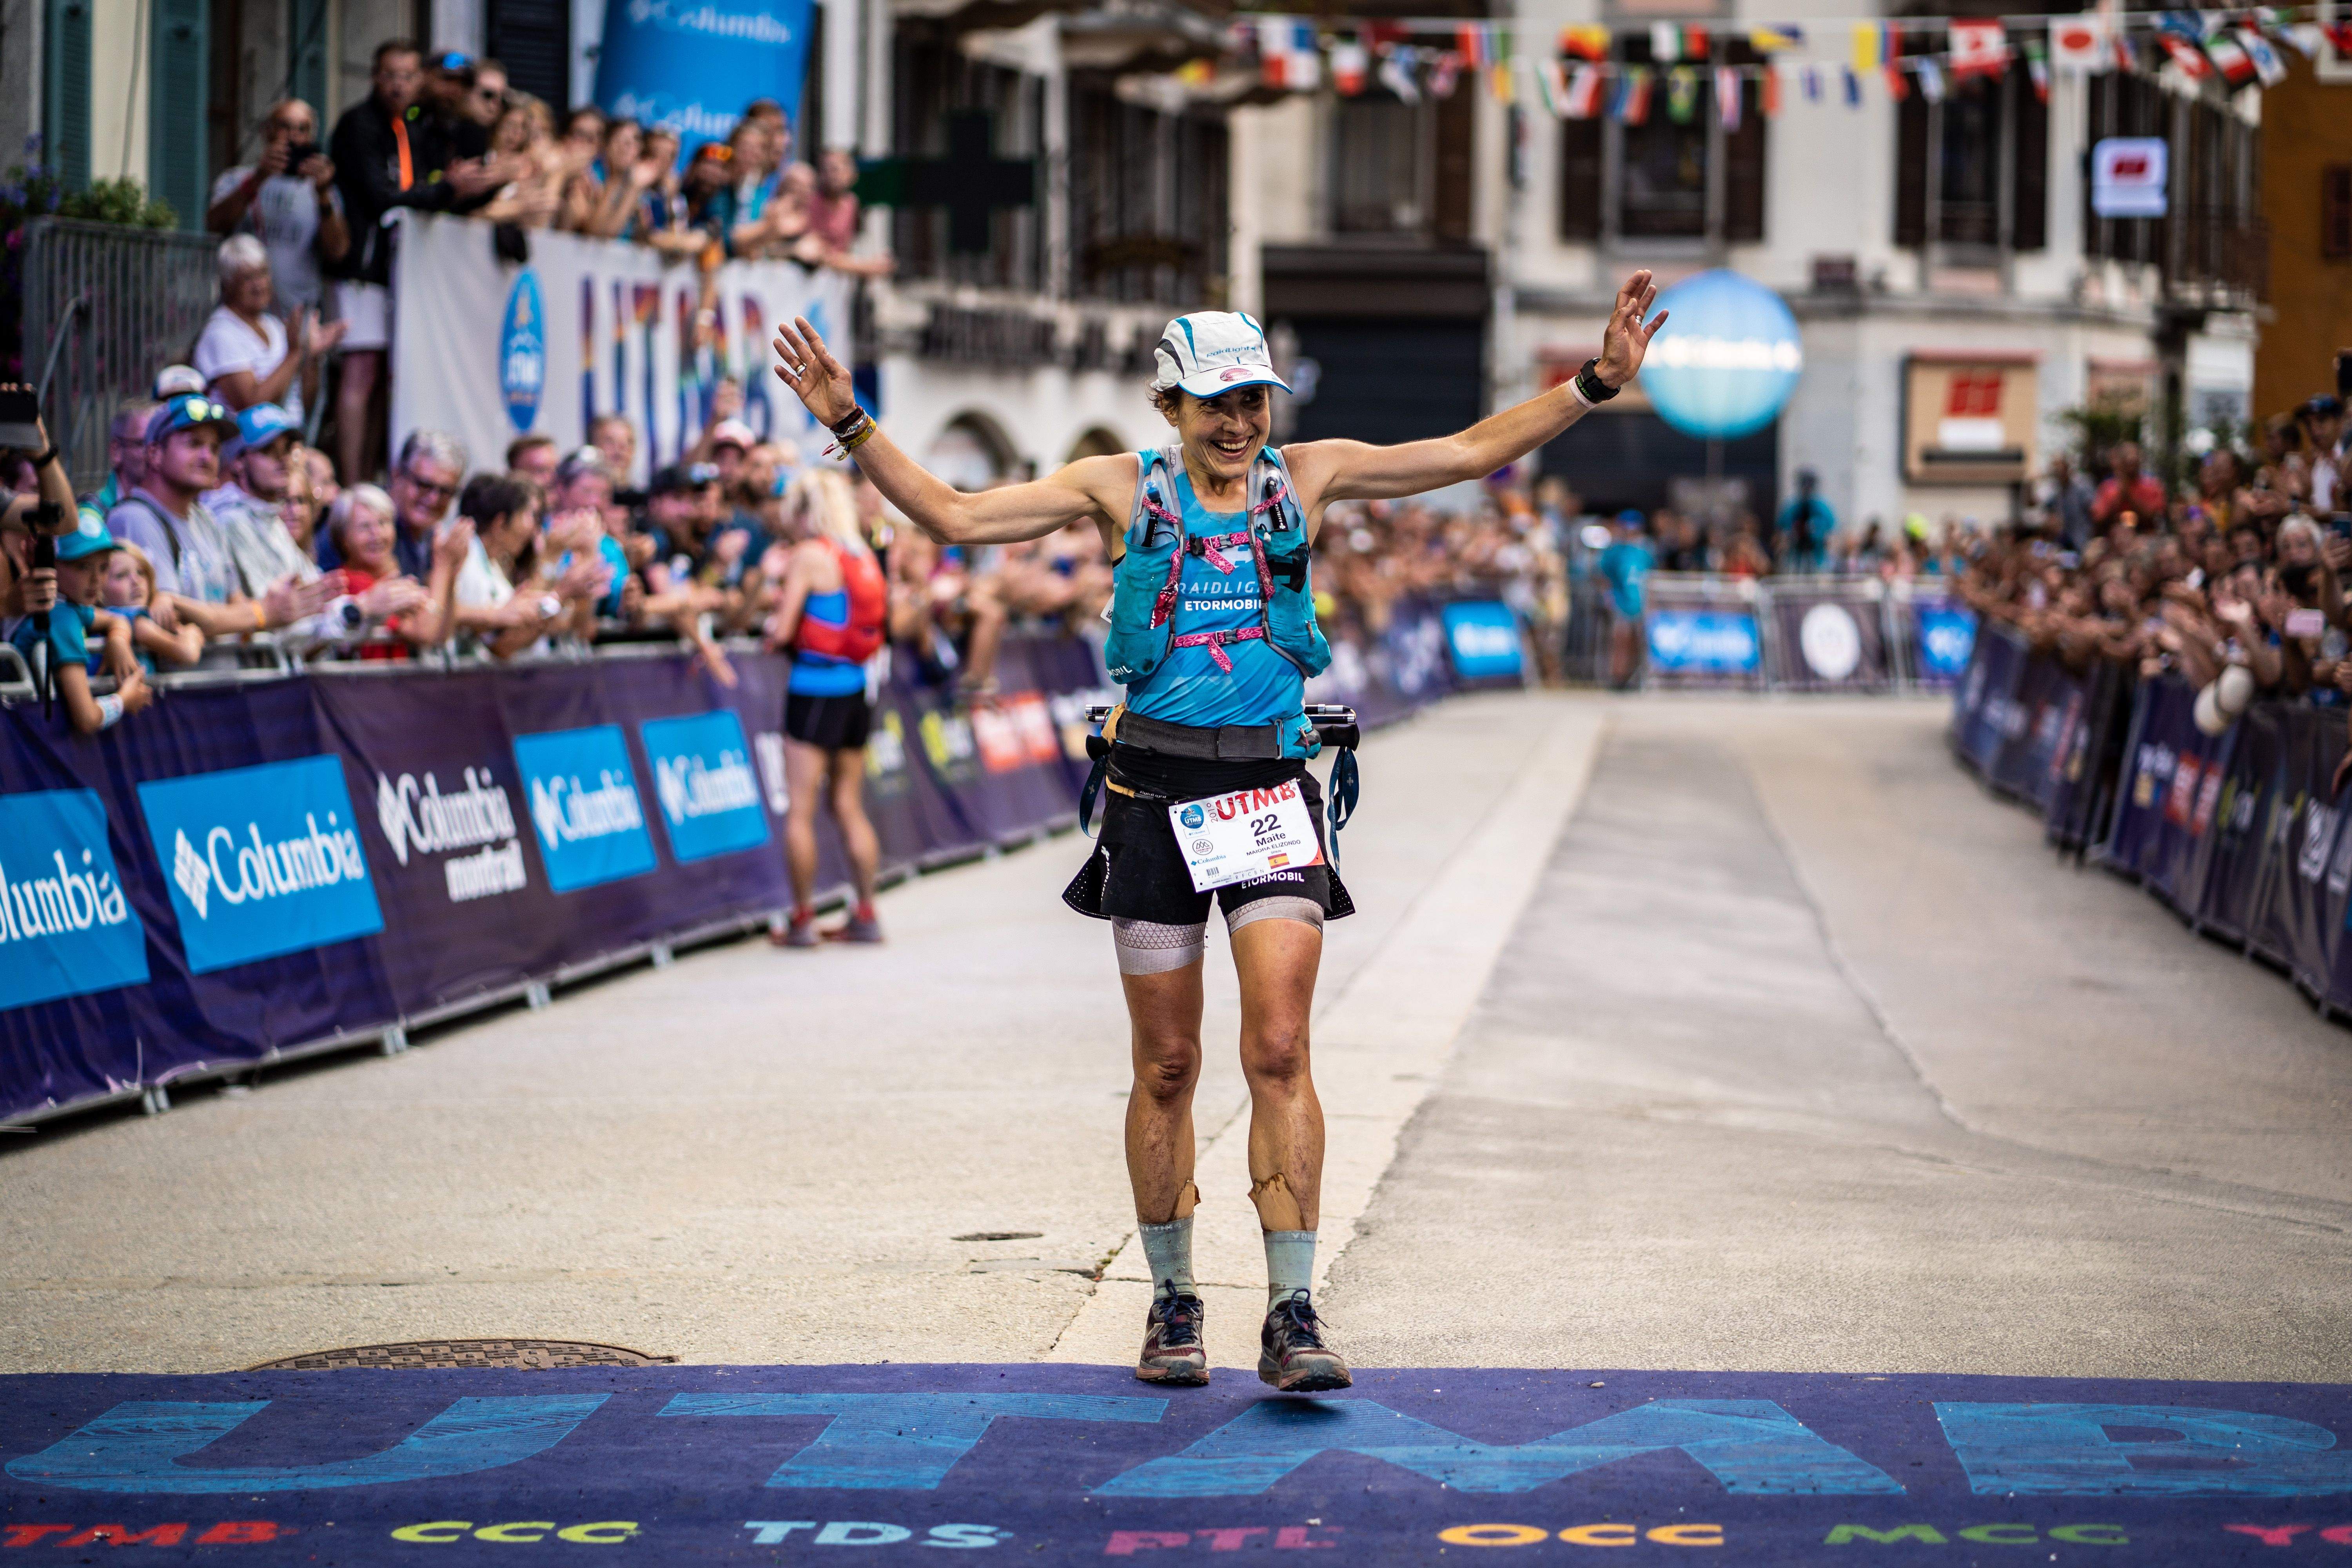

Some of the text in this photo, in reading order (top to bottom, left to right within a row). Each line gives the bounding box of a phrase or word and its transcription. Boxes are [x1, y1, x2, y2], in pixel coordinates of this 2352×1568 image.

[1206, 346, 1249, 358] RaidLight
[1581, 387, 1592, 399] NEVER
[1274, 504, 1283, 522] RAIDLIGH
[1179, 581, 1259, 594] RAIDLIG
[1107, 665, 1132, 677] MOBIL
[396, 766, 517, 855] Columbia
[1250, 814, 1281, 837] 22
[1246, 839, 1301, 856] MAIORA ELIZONDO
[1256, 833, 1286, 846] Maite
[207, 810, 365, 904] Columbia
[1197, 854, 1227, 864] Columbia
[0, 848, 127, 943] lumbia
[391, 1521, 638, 1543] CCC
[744, 1520, 1000, 1548] TDS
[1437, 1523, 1724, 1547] OCC
[1823, 1523, 2131, 1545] MCC
